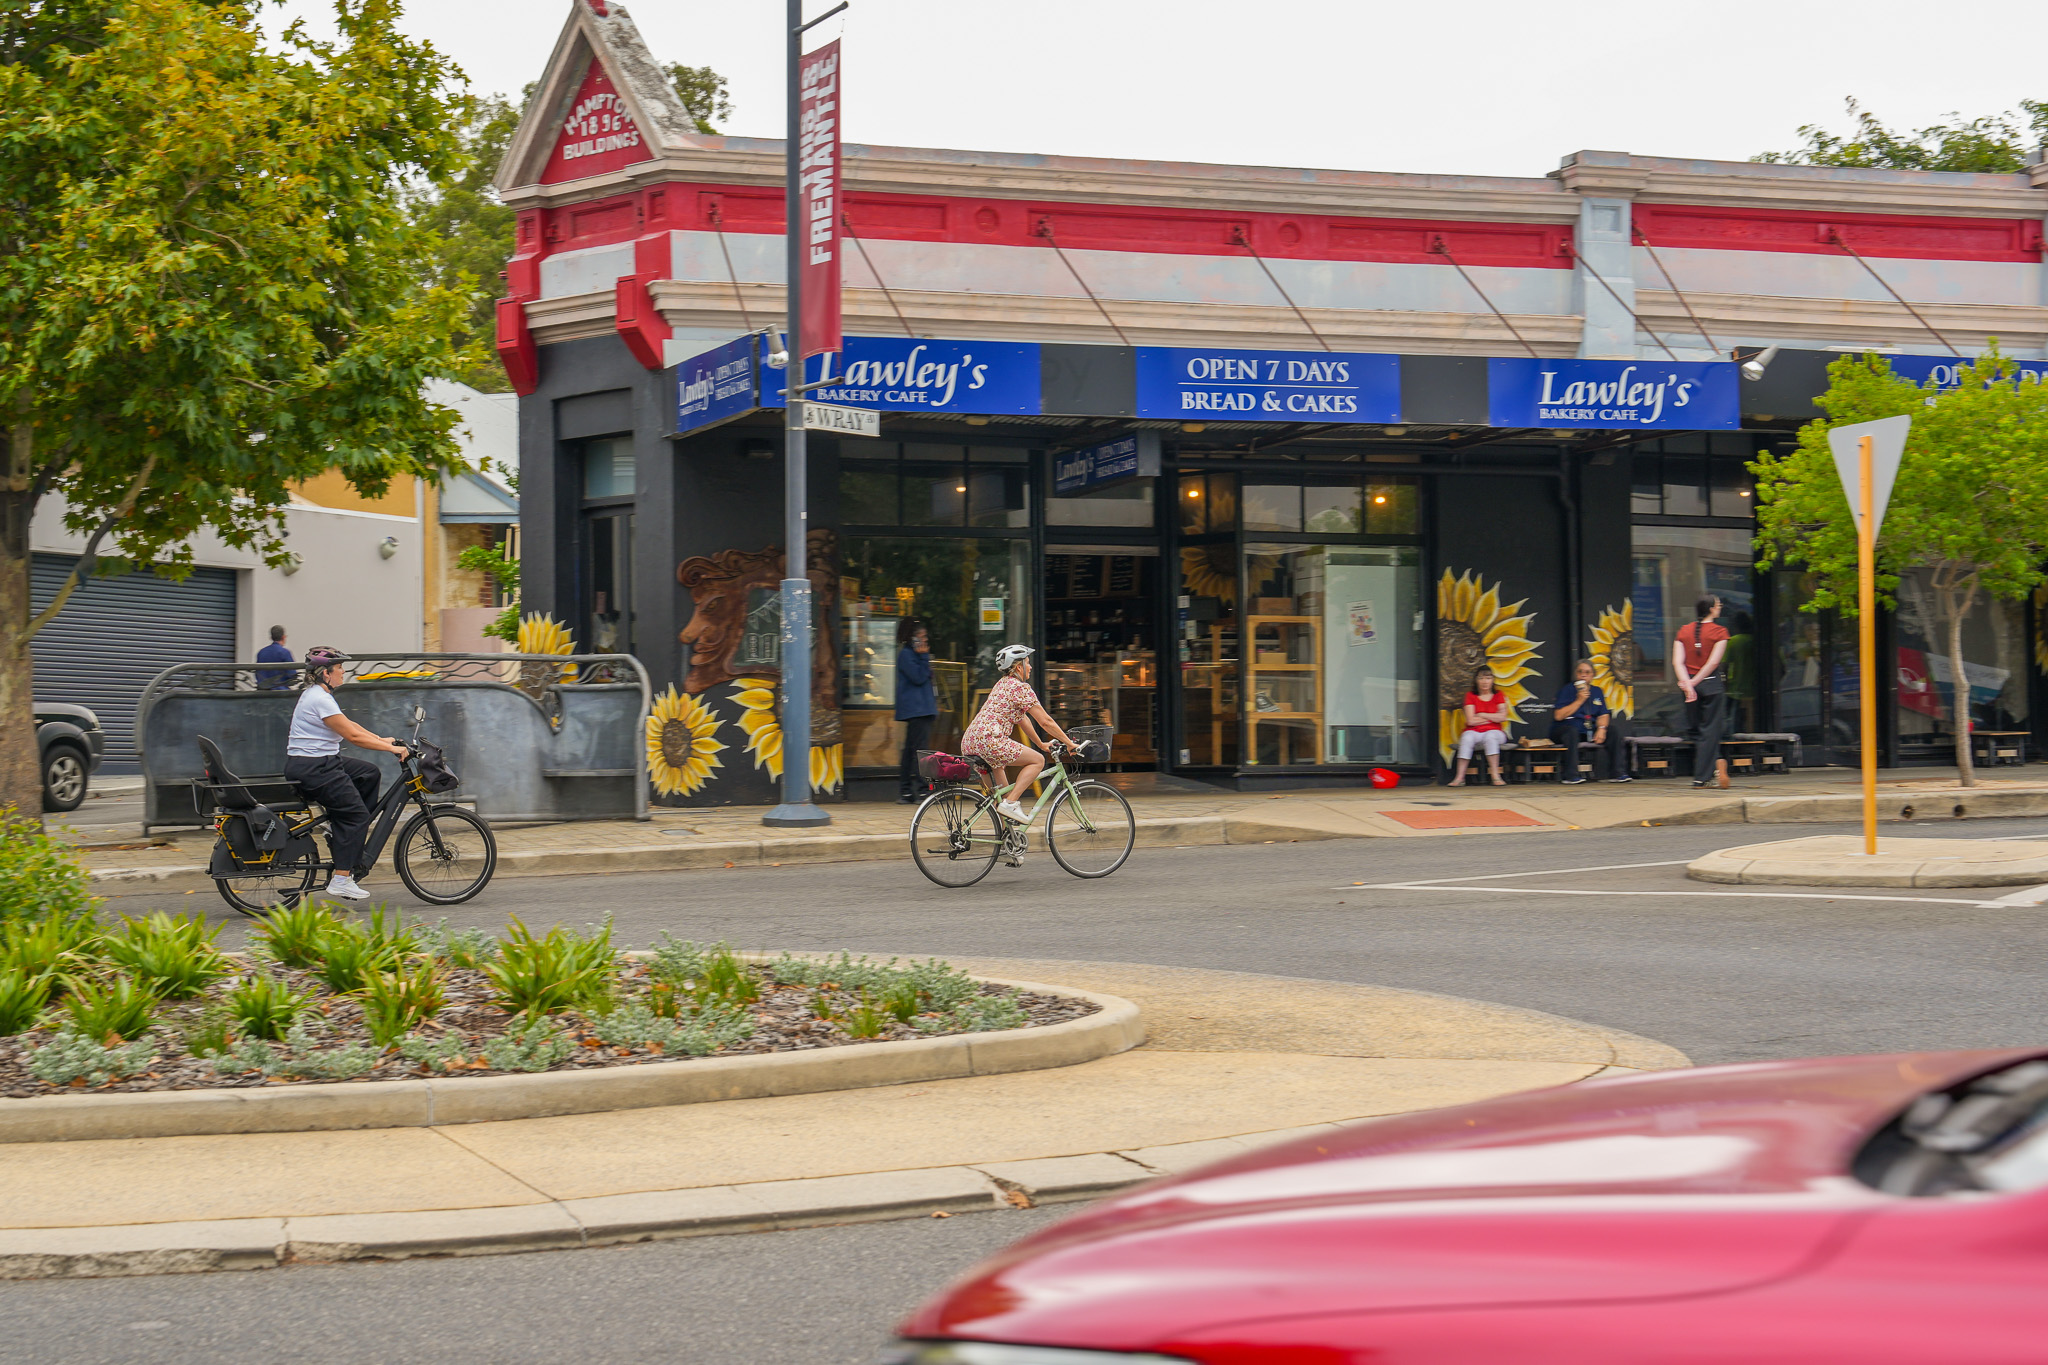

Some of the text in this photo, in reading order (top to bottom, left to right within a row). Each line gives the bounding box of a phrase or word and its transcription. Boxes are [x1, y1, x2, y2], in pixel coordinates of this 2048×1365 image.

[581, 114, 621, 136] 1896
[799, 63, 819, 194] THIS IS
[563, 131, 639, 160] BUILDINGS
[810, 53, 838, 266] FREMANTLE
[820, 345, 988, 406] Lawley's
[1187, 357, 1350, 383] OPEN 7 DAYS
[679, 369, 714, 411] Lawley's
[817, 388, 928, 403] BAKERY CAFE
[1180, 390, 1358, 413] BREAD & CAKES
[1537, 366, 1692, 424] Lawley's
[816, 407, 864, 430] WRAY
[1539, 408, 1638, 421] BAKERY CAFE
